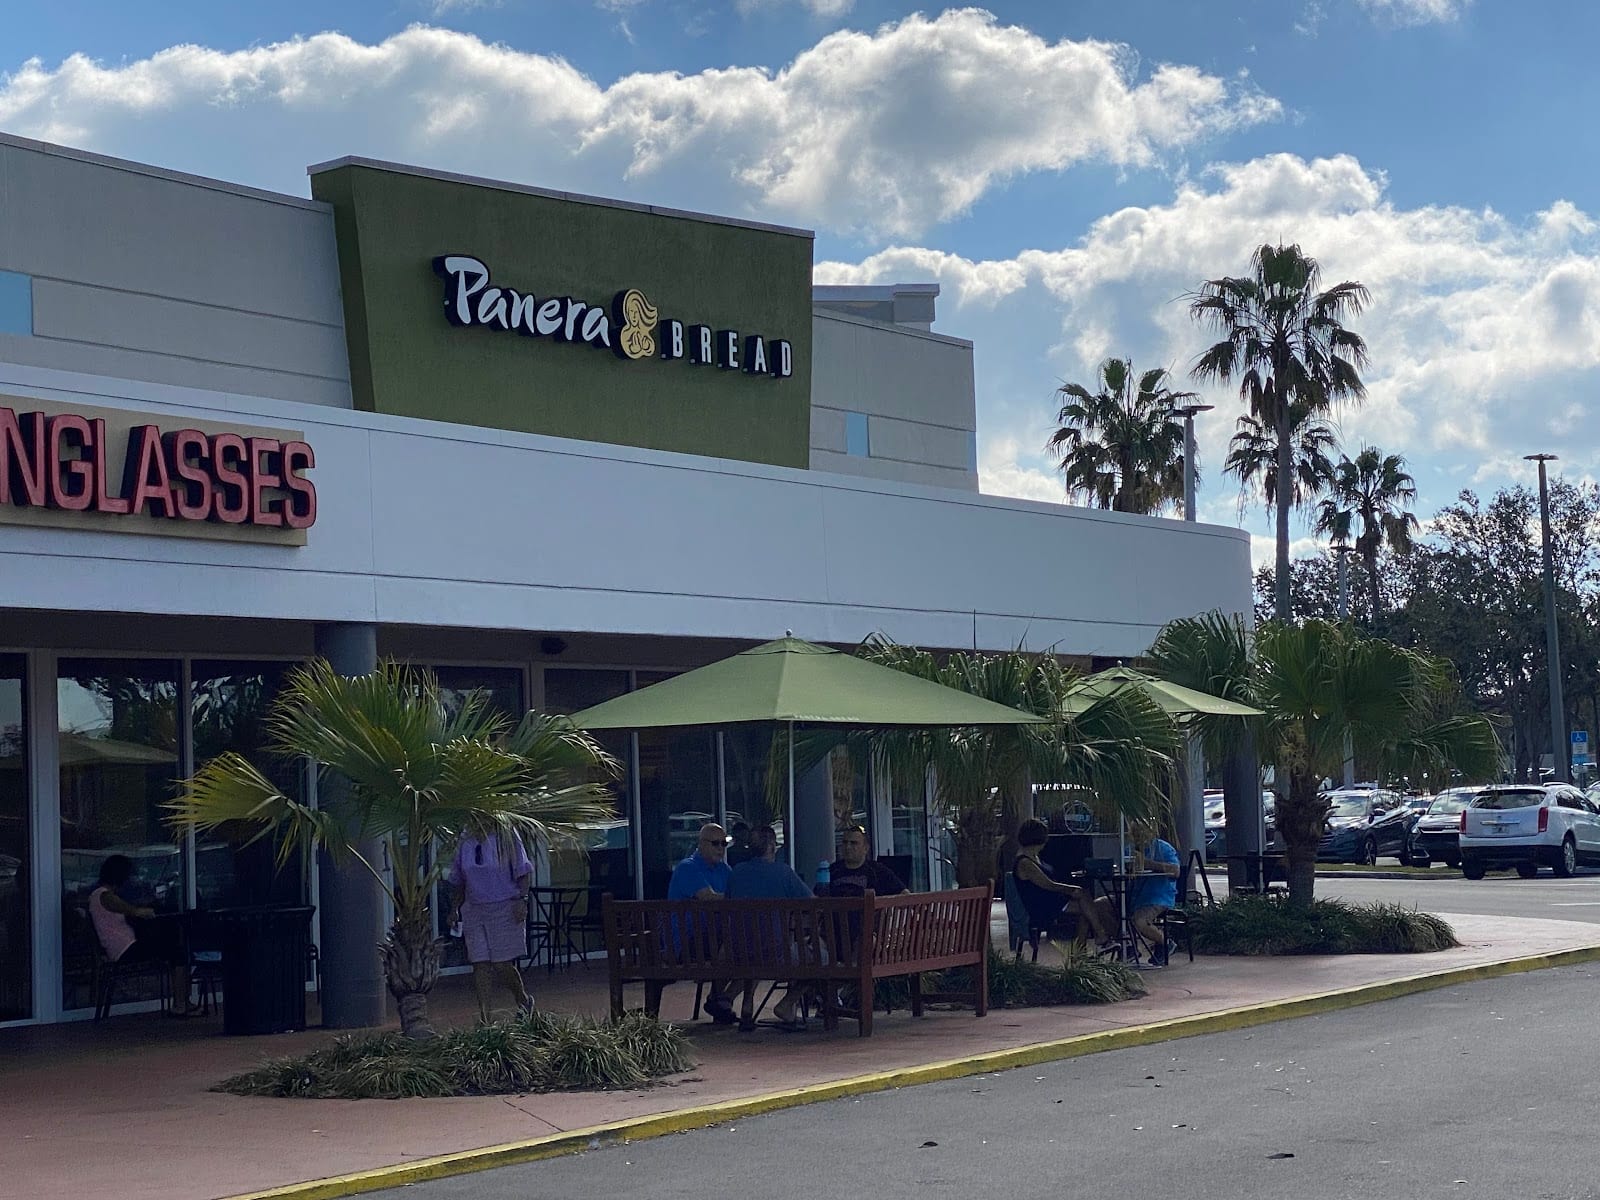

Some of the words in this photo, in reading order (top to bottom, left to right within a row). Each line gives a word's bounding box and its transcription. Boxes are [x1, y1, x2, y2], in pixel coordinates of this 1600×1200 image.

[444, 256, 611, 348] Panera
[669, 319, 792, 377] BREAD
[0, 407, 317, 529] NGLASSES
